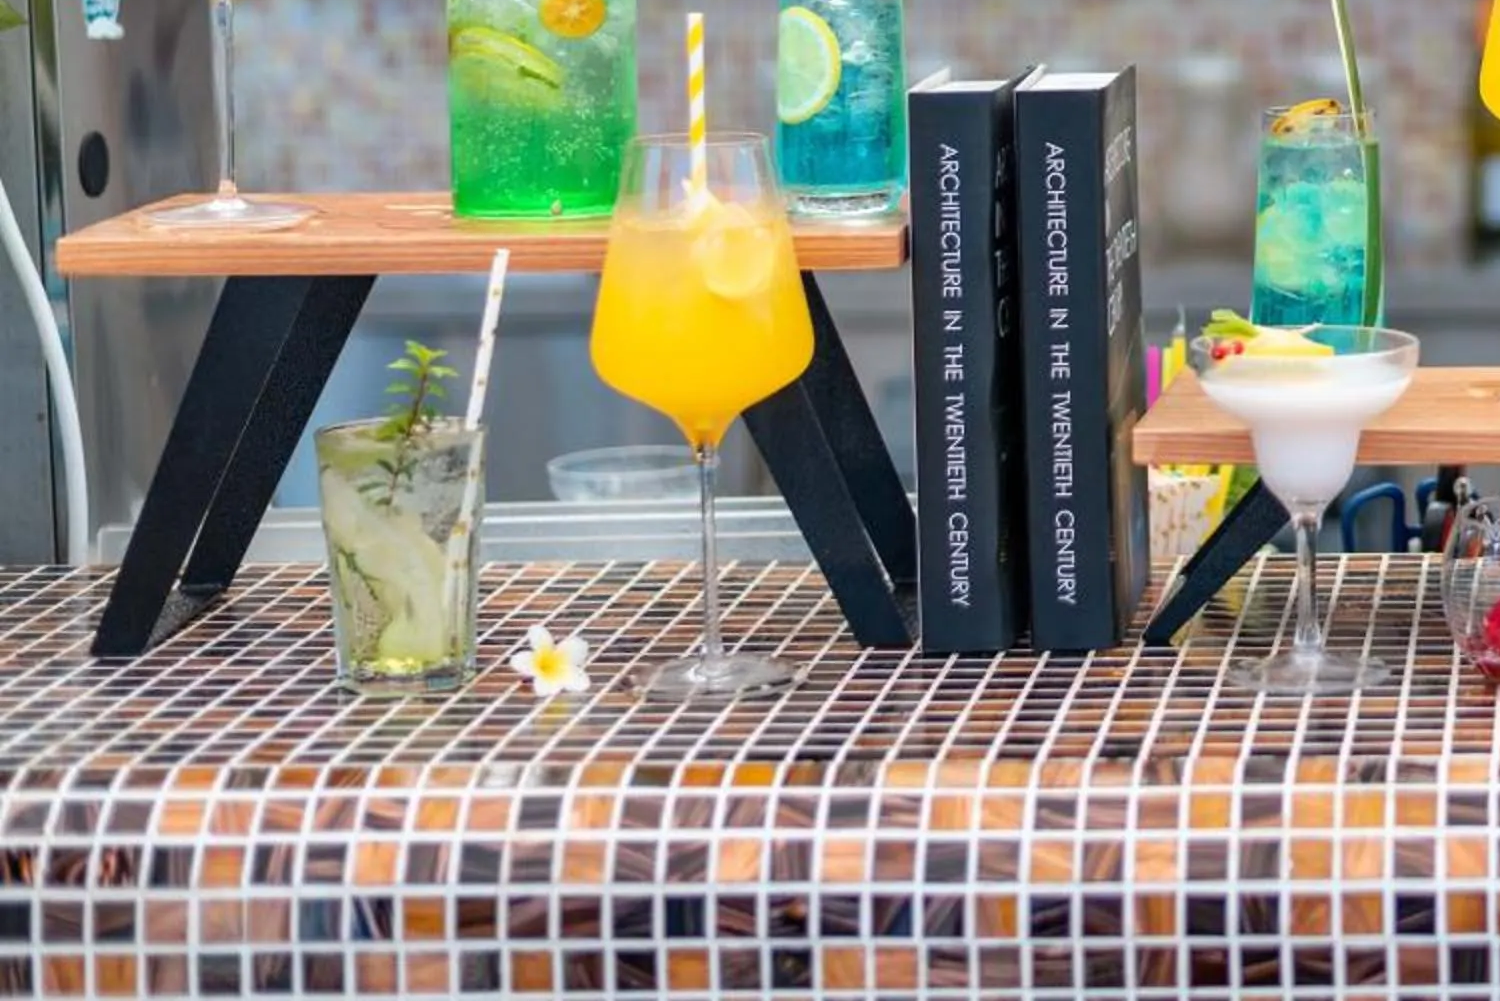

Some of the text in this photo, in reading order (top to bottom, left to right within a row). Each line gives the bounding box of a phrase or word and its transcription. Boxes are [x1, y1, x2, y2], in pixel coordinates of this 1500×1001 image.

[939, 143, 970, 607] ARCHITECTURE IN THE TWENTIETH CENTURY
[1045, 142, 1077, 605] ARCHITECTURE IN THE TWENTIETH CENTURY
